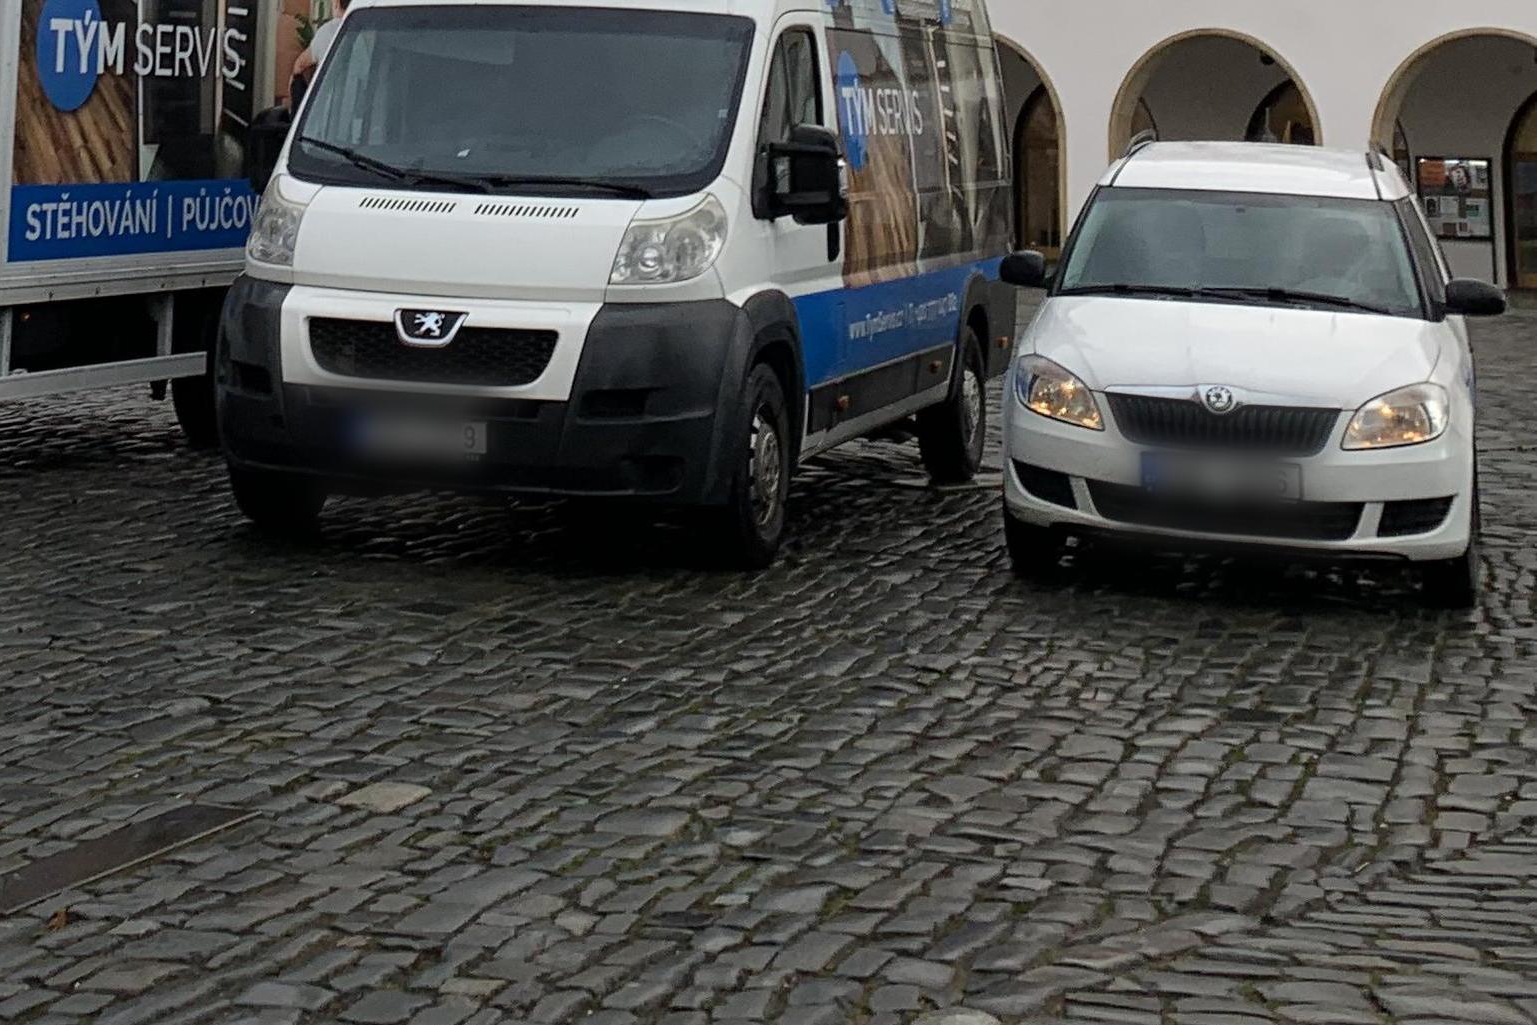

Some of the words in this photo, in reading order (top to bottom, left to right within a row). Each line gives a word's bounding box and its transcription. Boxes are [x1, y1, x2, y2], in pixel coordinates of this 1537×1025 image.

[50, 9, 126, 75] TÝM
[133, 23, 240, 78] SERVIS
[842, 78, 877, 136] TÝM
[877, 87, 923, 136] SERVIS
[25, 189, 158, 241] STĚHOVÁNÍ
